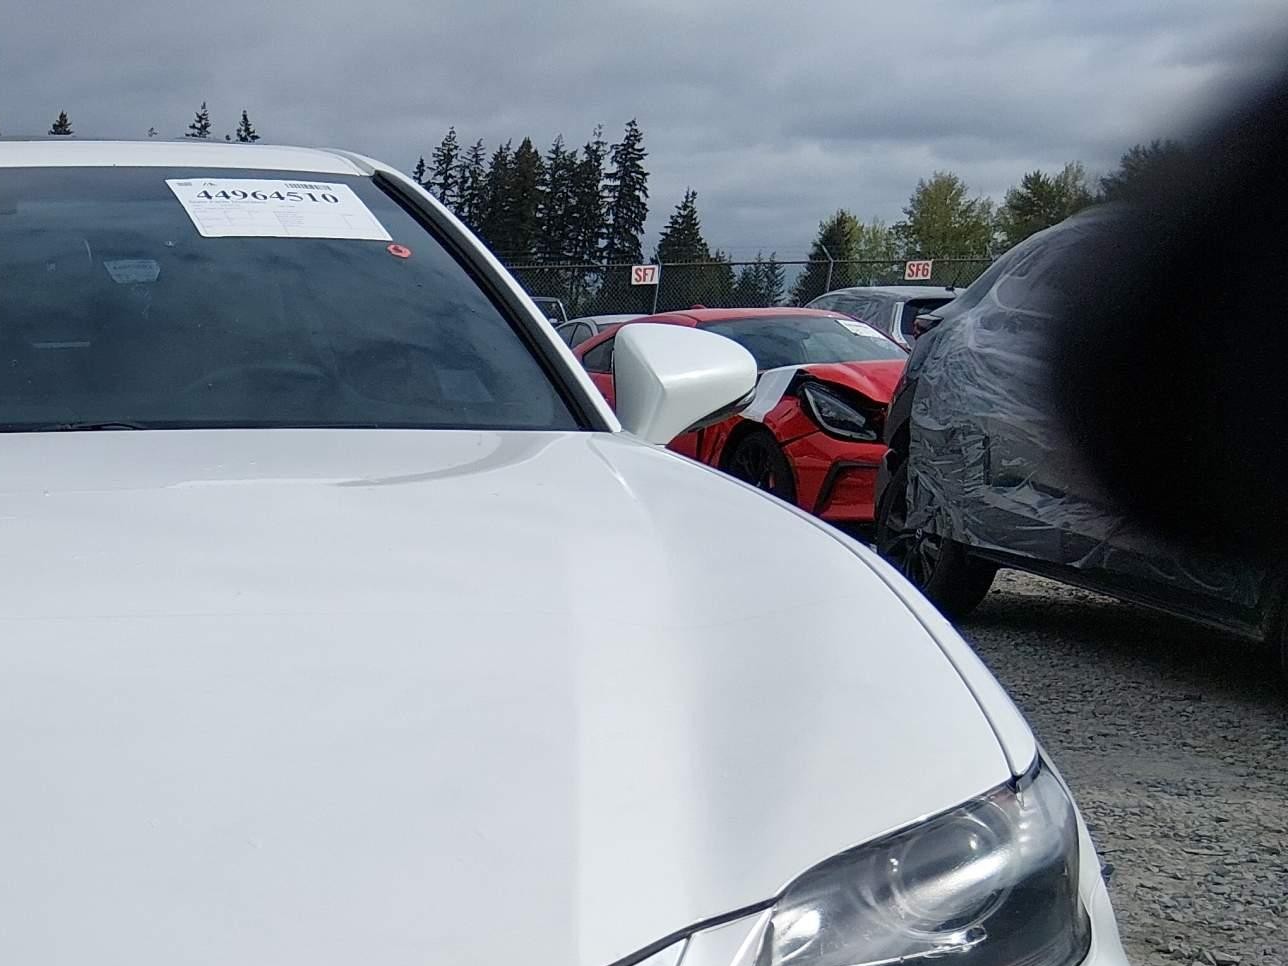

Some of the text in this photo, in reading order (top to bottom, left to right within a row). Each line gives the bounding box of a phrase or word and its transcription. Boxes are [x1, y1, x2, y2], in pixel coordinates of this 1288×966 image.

[196, 189, 340, 205] 44964510
[633, 267, 656, 283] SF7
[906, 262, 931, 278] SF6
